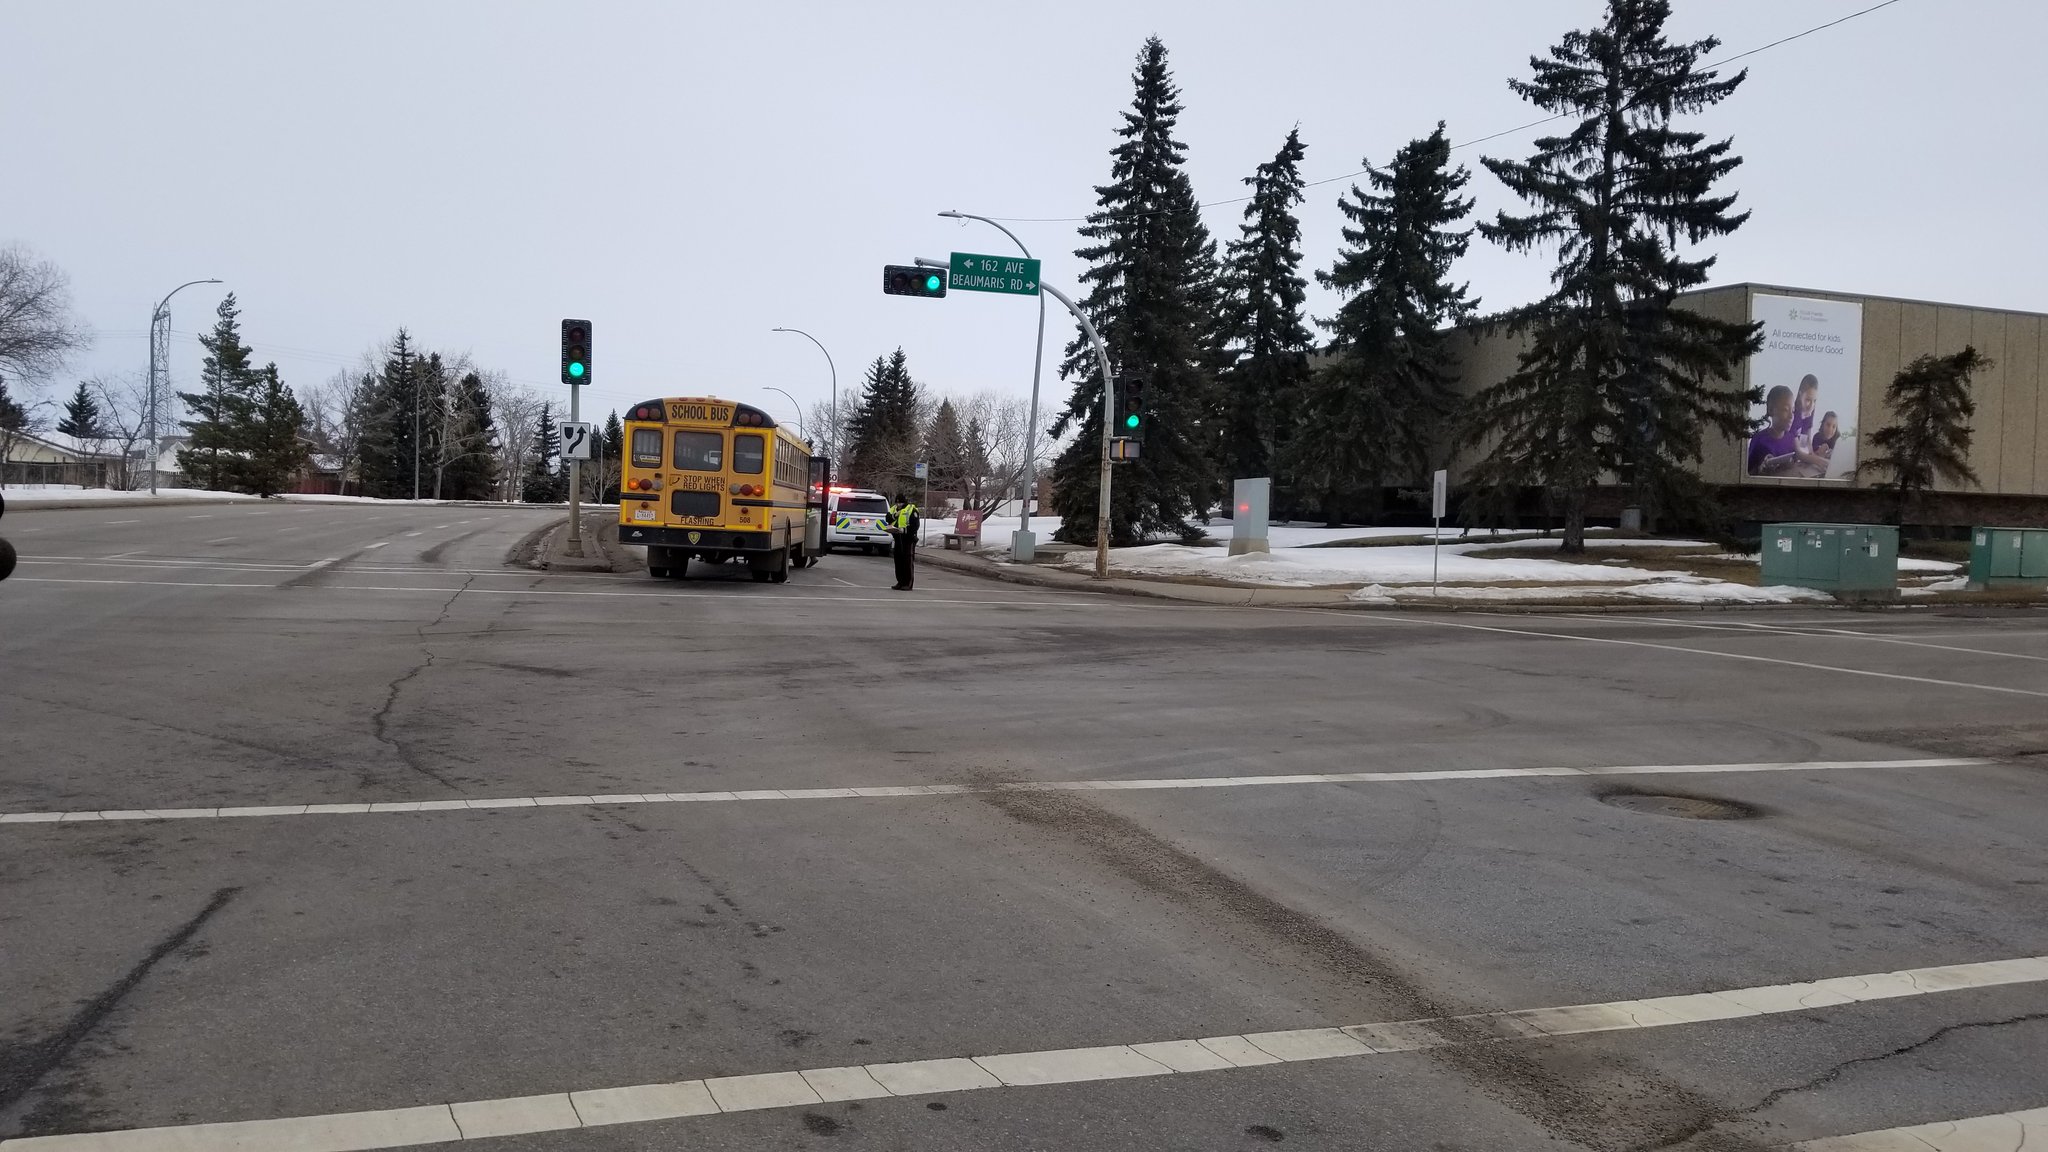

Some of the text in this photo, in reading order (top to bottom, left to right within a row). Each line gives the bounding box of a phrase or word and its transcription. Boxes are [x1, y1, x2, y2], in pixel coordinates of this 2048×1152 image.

[981, 259, 1024, 274] 162 AVE
[952, 273, 1023, 290] BEAUMARIS RD
[1772, 329, 1781, 337] All
[1782, 331, 1816, 341] connected
[1817, 332, 1826, 341] for
[1769, 340, 1777, 349] All
[1778, 341, 1814, 353] Connected
[1815, 344, 1824, 353] for
[671, 404, 729, 421] SCHOOL BUS
[683, 475, 725, 484] STOP WHEN
[683, 482, 725, 492] RED LIGHTS
[680, 516, 714, 526] FLASHING
